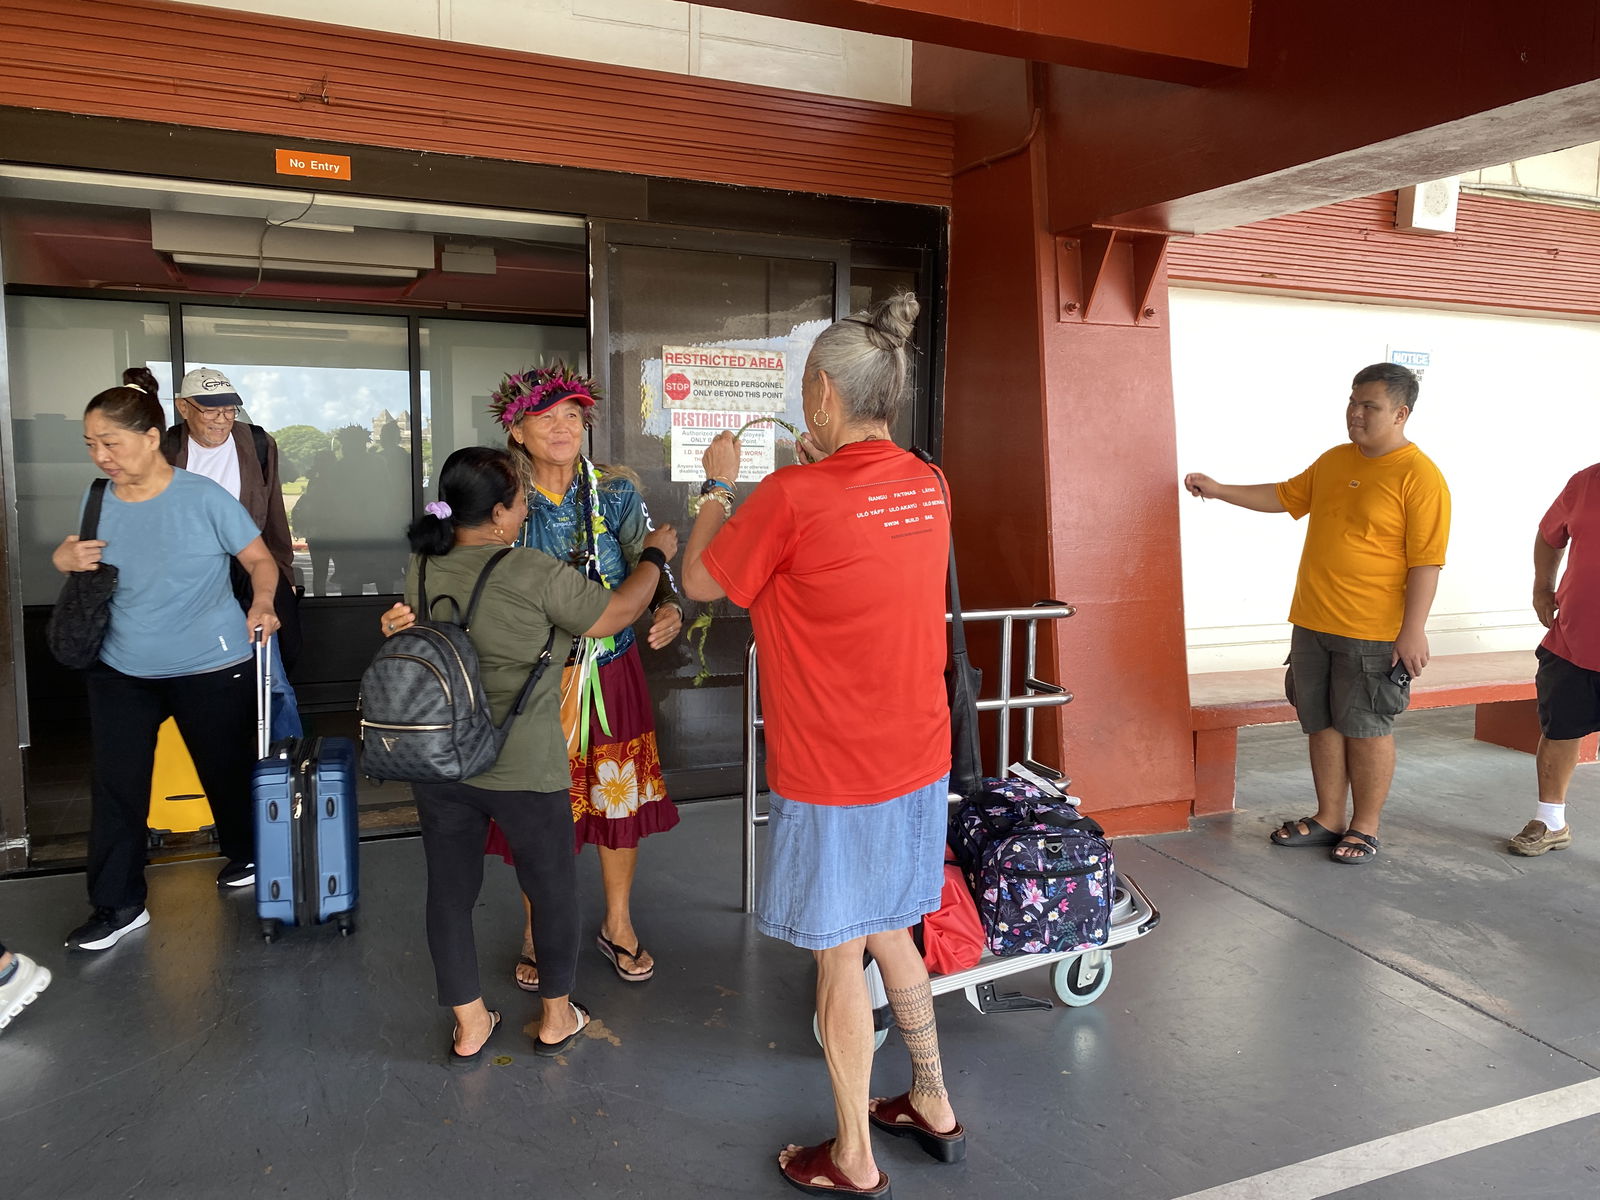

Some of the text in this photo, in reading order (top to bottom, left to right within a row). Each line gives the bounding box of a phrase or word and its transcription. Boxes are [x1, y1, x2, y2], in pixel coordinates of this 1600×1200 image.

[289, 158, 340, 174] No Entry
[665, 352, 784, 369] RESTRICTED AREA
[666, 382, 690, 391] STOP
[693, 379, 784, 389] AUTHORIZED PERSONNEL
[693, 389, 713, 397] ONLY
[714, 390, 744, 398] BEYOND
[673, 412, 741, 428] RESTRICTED
